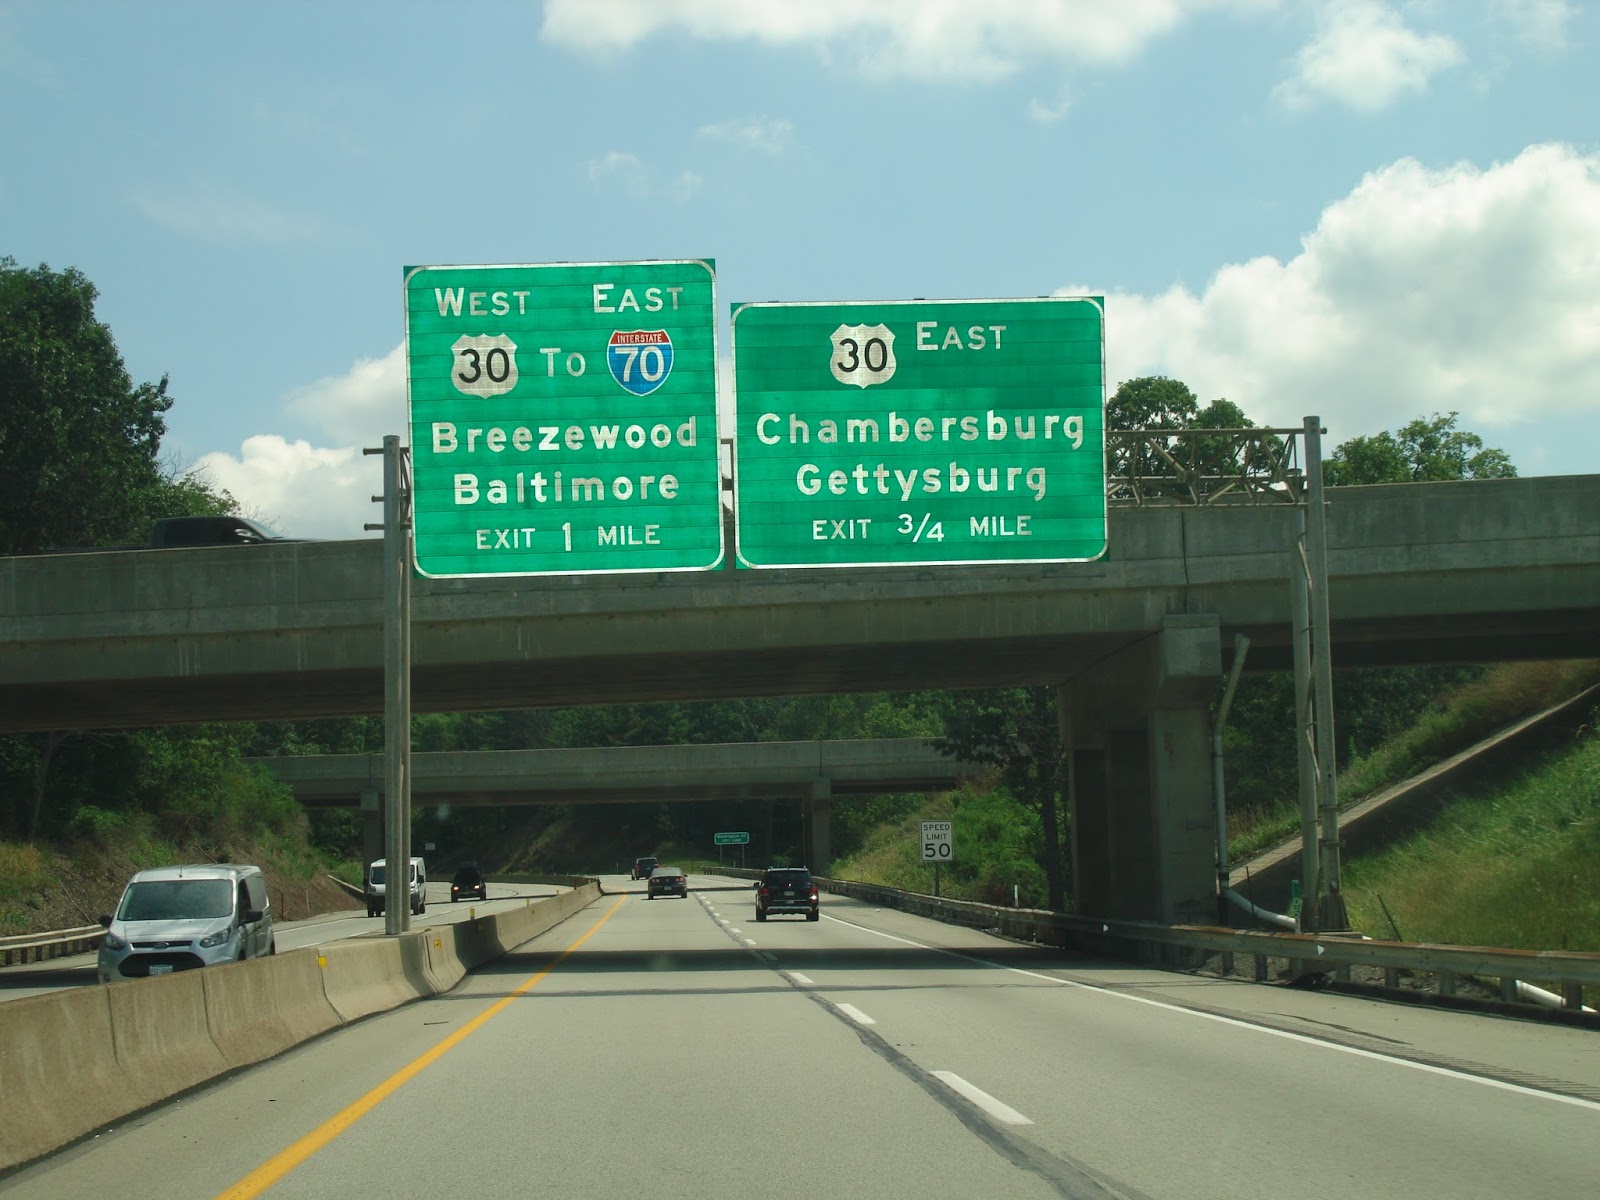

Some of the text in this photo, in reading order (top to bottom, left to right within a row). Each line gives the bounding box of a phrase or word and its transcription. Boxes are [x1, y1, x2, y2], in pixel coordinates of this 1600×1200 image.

[434, 287, 531, 317] WEST
[593, 283, 684, 314] EAST
[617, 333, 662, 344] INTERSTATE
[916, 321, 1007, 351] EAST
[458, 348, 510, 383] 30
[614, 346, 665, 382] 70
[837, 338, 888, 373] 30
[432, 416, 697, 454] Breezewood
[756, 410, 1084, 450] Chambersburg
[454, 471, 679, 505] Baltimore
[796, 462, 1047, 502] Gettysburg
[476, 522, 660, 551] EXIT 1 MILE
[812, 512, 1032, 543] EXIT 3/4 MILE
[924, 842, 951, 858] 50
